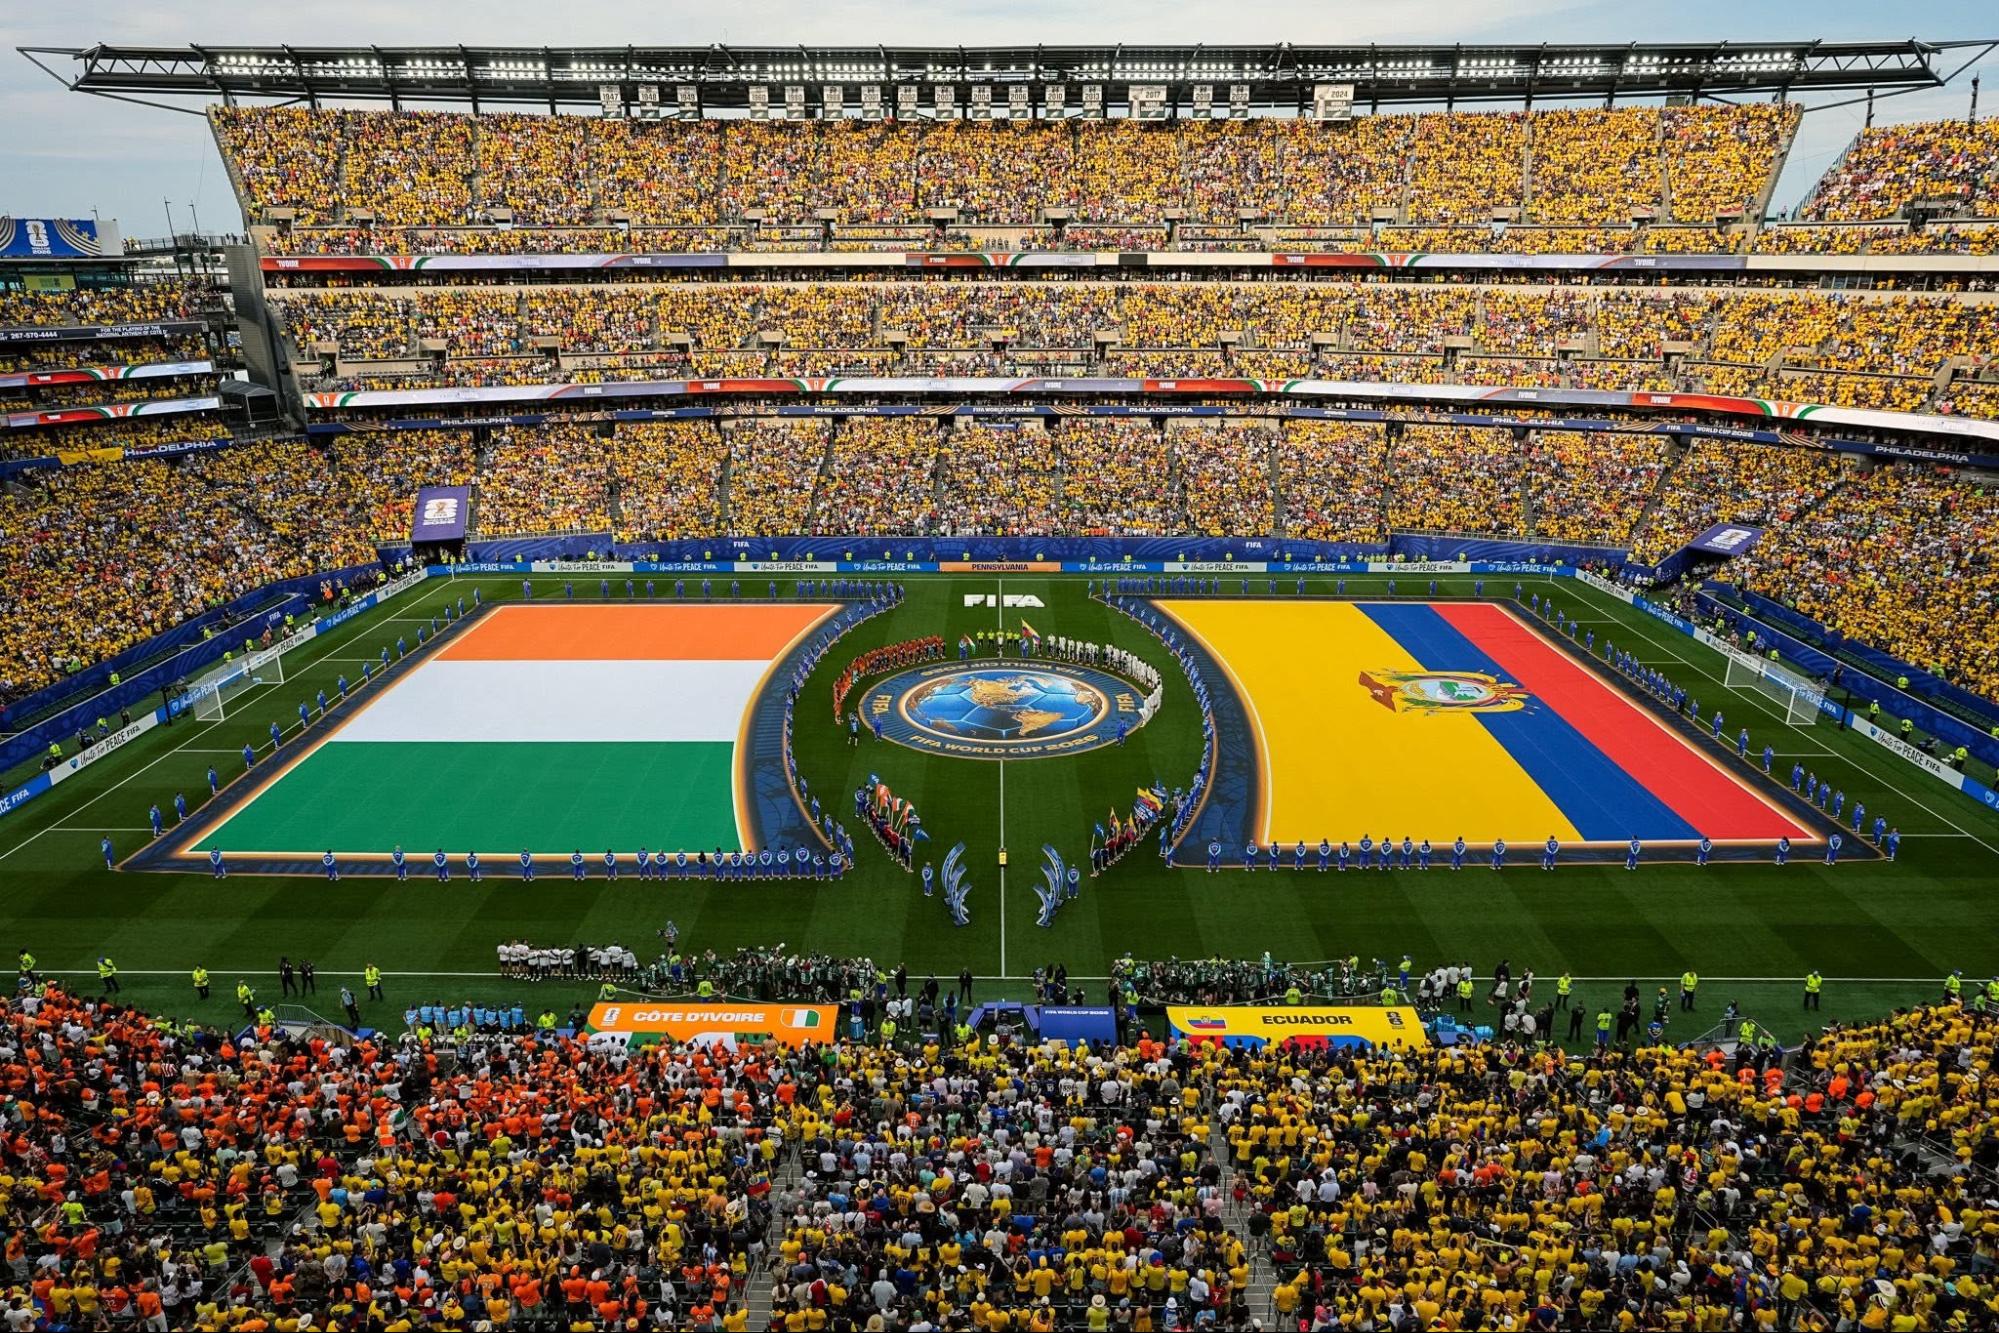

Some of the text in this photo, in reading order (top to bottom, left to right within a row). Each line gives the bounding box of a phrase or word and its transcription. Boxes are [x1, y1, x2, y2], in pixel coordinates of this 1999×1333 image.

[10, 331, 58, 340] 267-570-4444
[440, 417, 512, 426] PHILADELPHIA
[1492, 418, 1565, 426] PHILAELPHIA
[1875, 445, 1969, 462] PHILADELPHIA
[480, 564, 500, 572] PEACE
[1521, 564, 1542, 572] PEACE
[1603, 582, 1616, 593] PEACE
[963, 594, 1045, 608] FIFA
[269, 612, 281, 622] FIFA
[348, 604, 359, 618] PEACE
[1662, 612, 1674, 624] PEACE
[1674, 619, 1684, 628] FIFA
[281, 639, 294, 653] PEACE
[295, 634, 304, 643] FIFA
[872, 694, 893, 715] FIFA
[1114, 692, 1135, 712] FIFA
[1824, 702, 1836, 714] FIFA
[80, 724, 141, 766] Unite For PEACE FIFA
[910, 736, 940, 748] FIFA
[944, 744, 1005, 753] WORLD
[1045, 735, 1099, 751] 2026
[1878, 731, 1941, 773] Unite For PEACE FIFA
[12, 788, 30, 804] FIFA
[633, 1009, 765, 1022] CÔTE D'IVOIRE
[1262, 1015, 1353, 1025] ECUADOR
[615, 1234, 623, 1243] 11
[1053, 1253, 1063, 1262] 10
